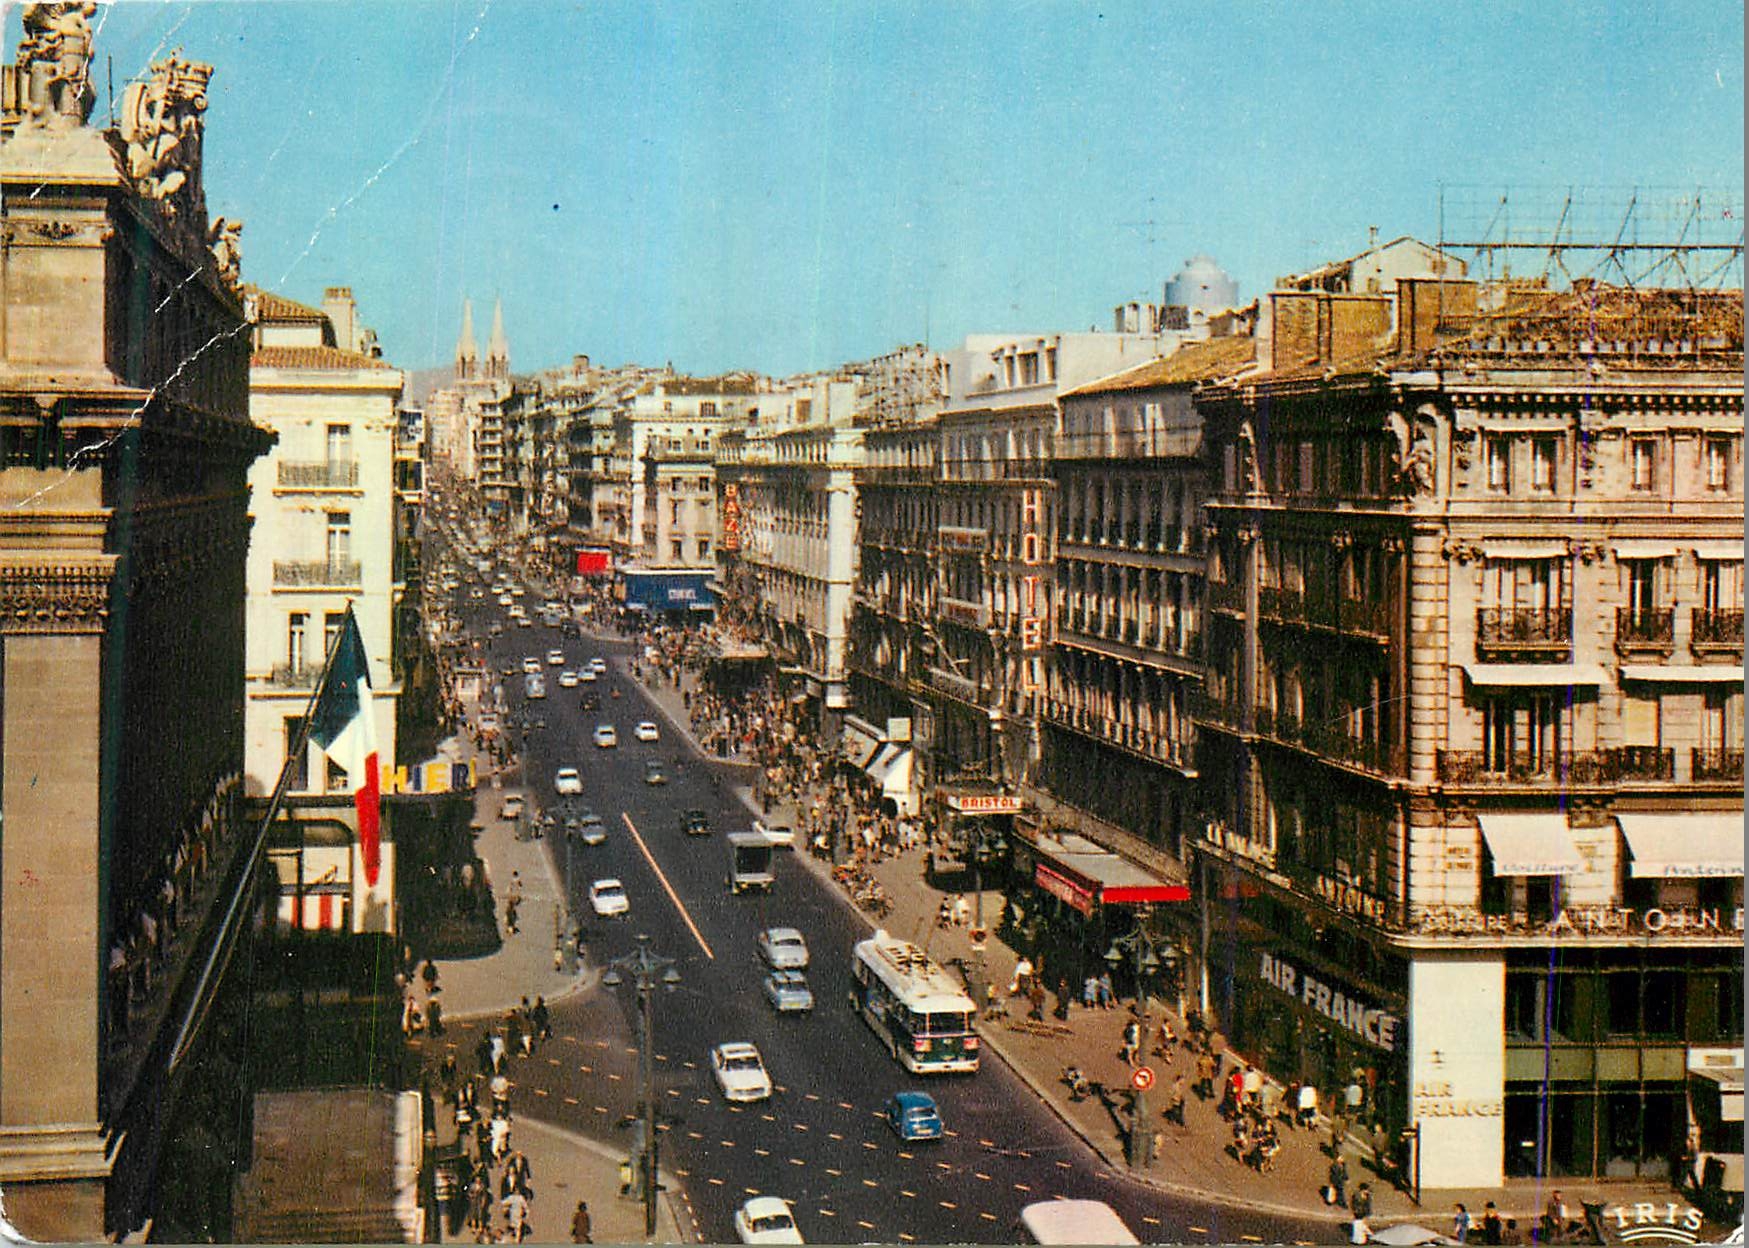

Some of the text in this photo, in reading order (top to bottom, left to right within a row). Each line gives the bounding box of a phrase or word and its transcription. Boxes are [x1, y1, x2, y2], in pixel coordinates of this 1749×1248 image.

[1022, 488, 1042, 691] HOTEL
[961, 797, 1015, 808] BRISTOL
[1260, 952, 1399, 1051] AIR FRANCE
[1415, 1082, 1453, 1098] AIR
[1415, 1102, 1502, 1118] FRANCE
